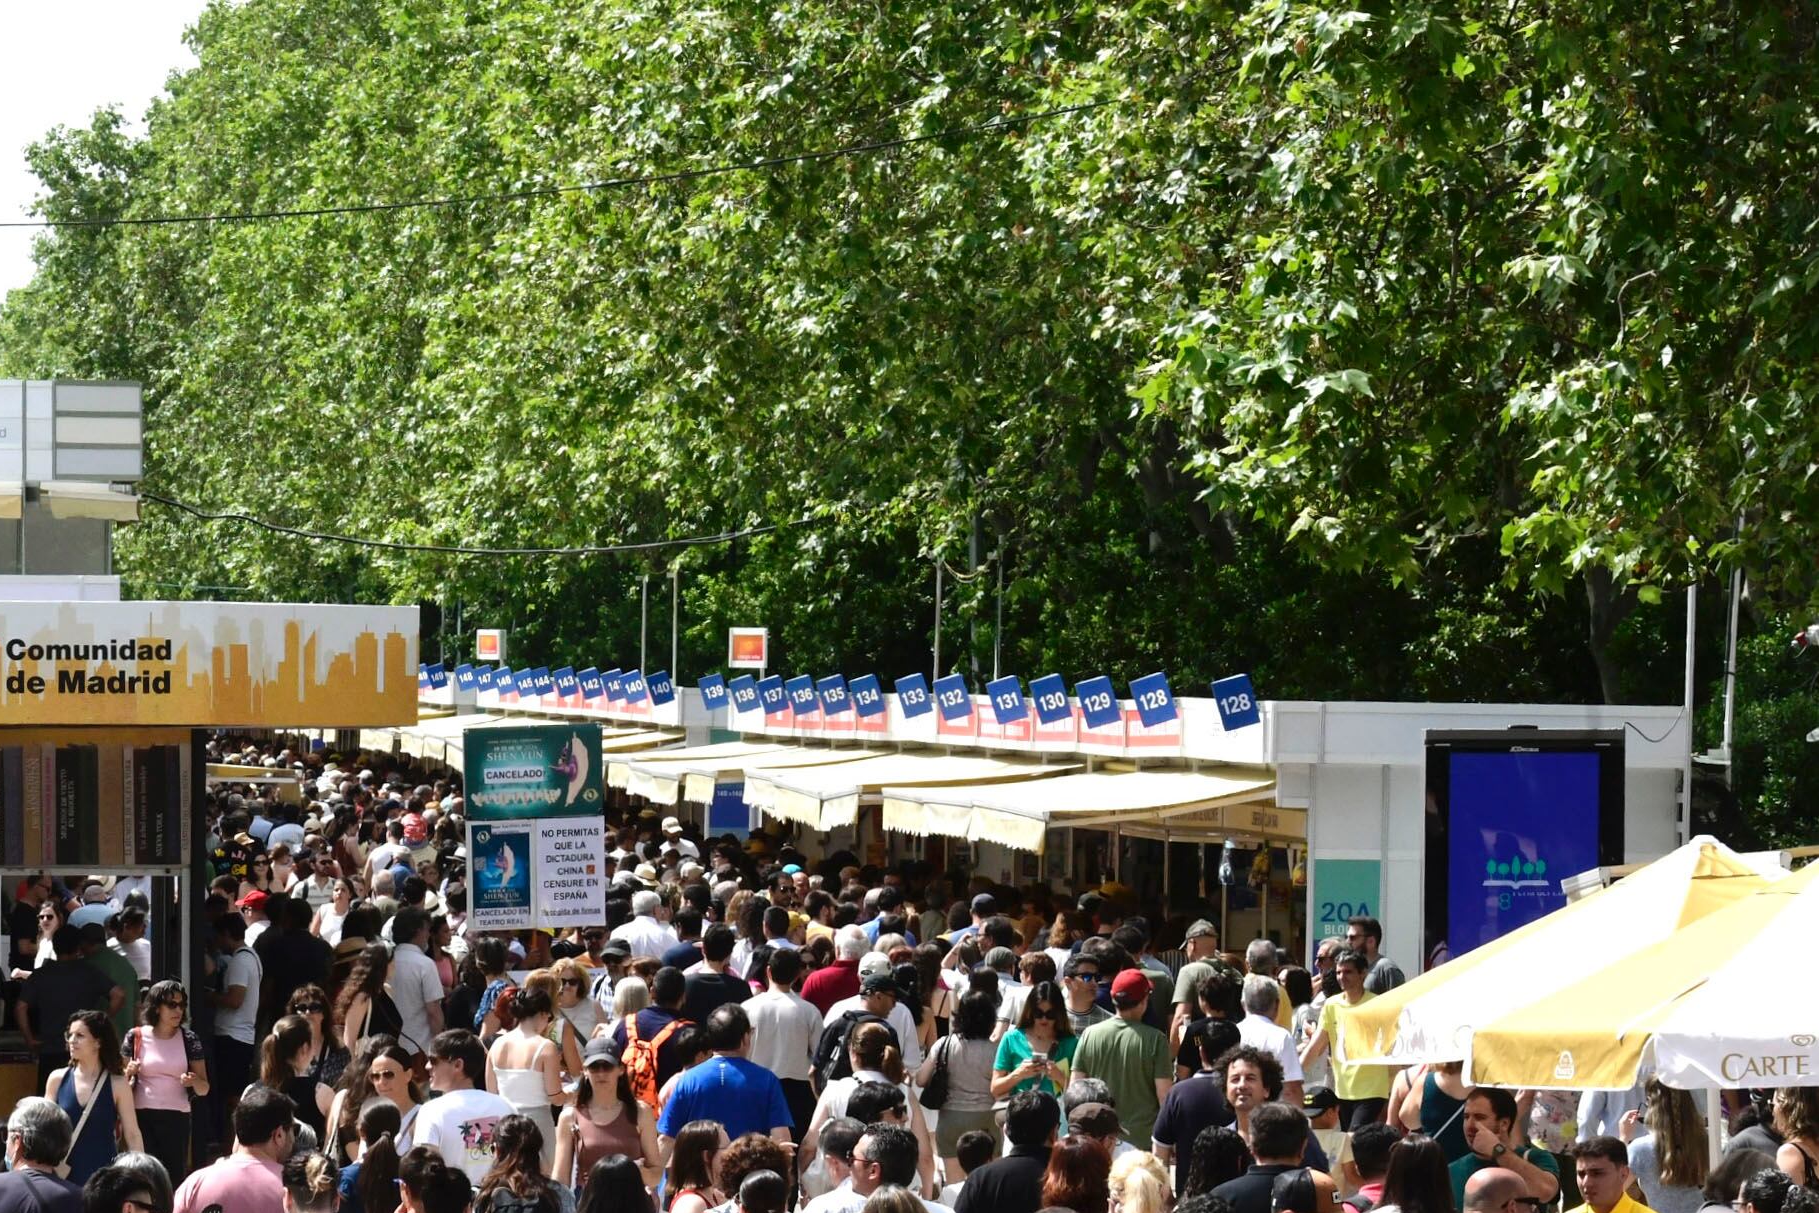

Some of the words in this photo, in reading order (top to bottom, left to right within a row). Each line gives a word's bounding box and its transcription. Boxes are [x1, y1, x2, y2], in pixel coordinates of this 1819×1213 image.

[5, 639, 172, 661] Comunidad
[6, 670, 45, 694] de
[58, 669, 172, 694] Madrid
[419, 672, 428, 682] 49
[459, 671, 473, 683] 148
[478, 673, 491, 684] 147
[518, 678, 532, 689] 145
[534, 675, 550, 688] 144
[558, 675, 574, 689] 143
[582, 678, 600, 691] 142
[625, 679, 643, 693] 140
[651, 681, 670, 695] 140
[704, 685, 724, 699] 139
[735, 687, 755, 702] 138
[763, 687, 782, 702] 137
[792, 687, 813, 702] 136
[823, 687, 845, 702] 135
[856, 689, 879, 705] 134
[901, 690, 925, 707] 133
[940, 689, 964, 708] 132
[996, 691, 1019, 710] 131
[1039, 691, 1065, 712] 130
[1084, 692, 1110, 713] 129
[1139, 689, 1168, 711] 128
[1220, 693, 1252, 716] 128
[485, 769, 543, 780] CANCELADO
[541, 829, 554, 838] NO
[556, 828, 599, 838] PERMITAS
[155, 833, 164, 857] NUEVA
[554, 841, 572, 850] QUE
[575, 841, 586, 849] LA
[546, 853, 595, 864] DICTADURA
[557, 867, 584, 876] CHINA
[543, 878, 585, 888] CENSURE
[587, 878, 598, 887] EN
[553, 890, 588, 901] ESPAÑA
[475, 909, 518, 917] CANCELADO
[1320, 901, 1370, 922] 20A
[1721, 1053, 1811, 1082] CARTE
